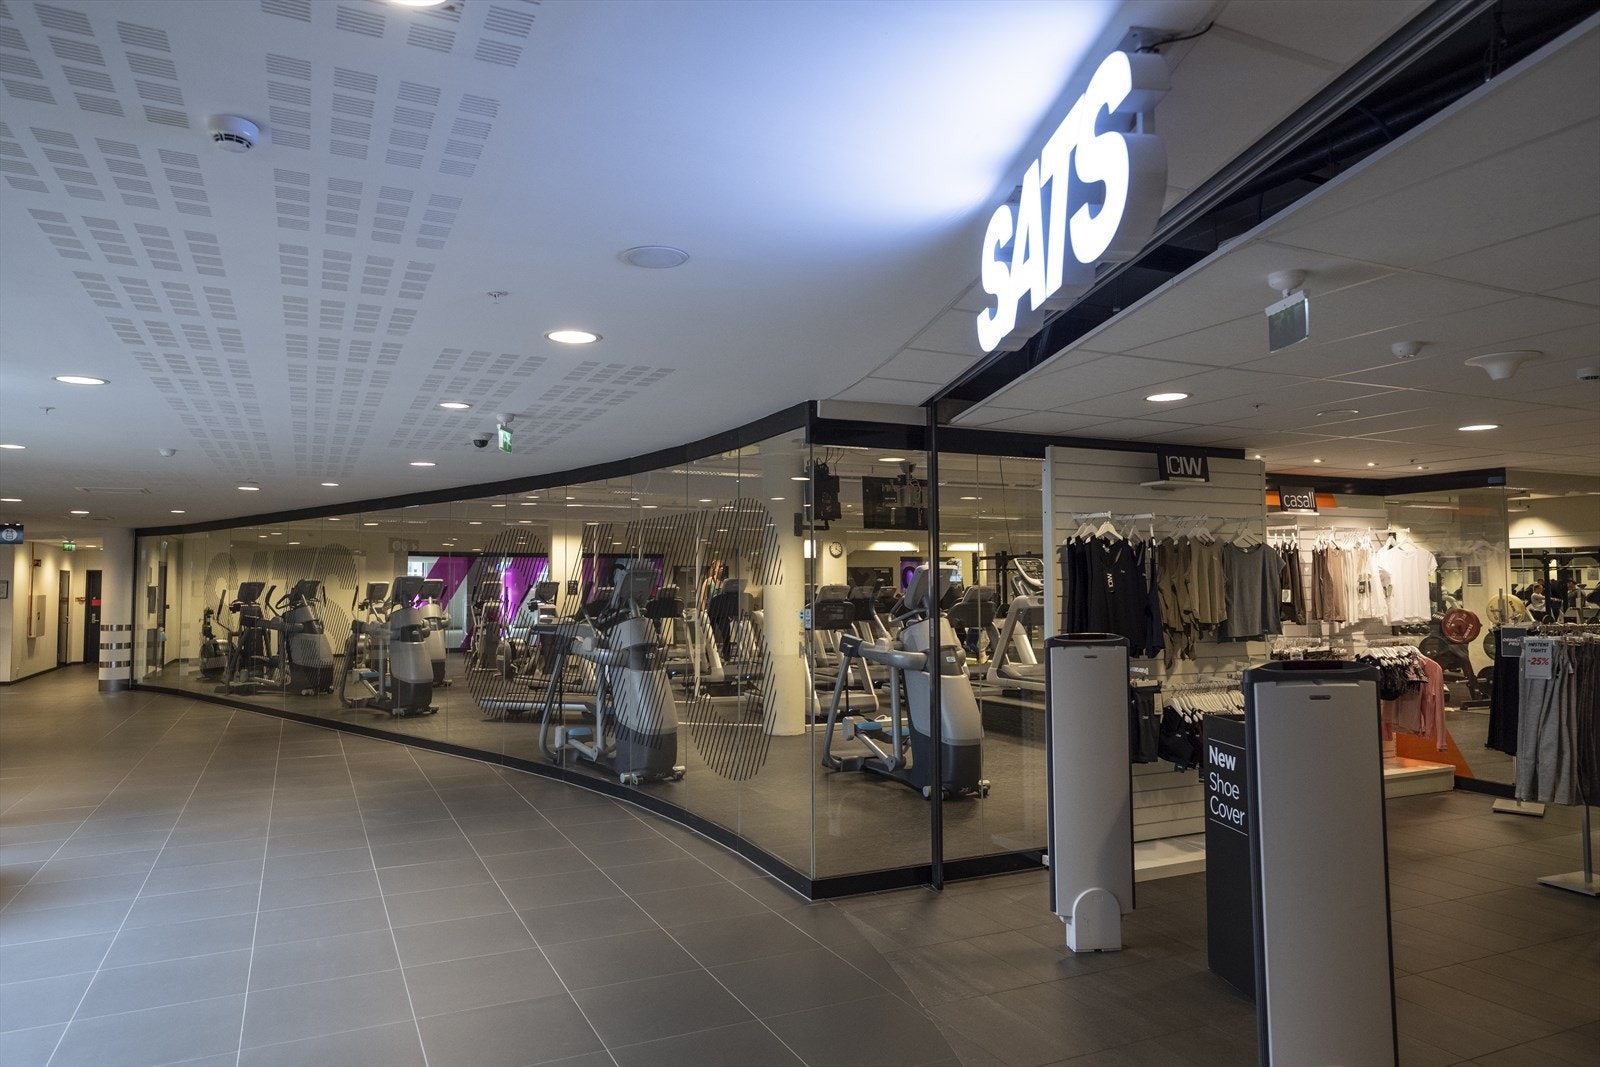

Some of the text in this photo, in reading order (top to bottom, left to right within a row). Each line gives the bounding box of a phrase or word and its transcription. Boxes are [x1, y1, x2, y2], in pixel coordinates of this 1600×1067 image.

[977, 50, 1132, 352] SATS
[1165, 455, 1202, 475] ICIW
[1283, 491, 1316, 508] casall
[1527, 657, 1550, 666] -25%
[1208, 744, 1237, 771] New
[1209, 771, 1240, 800] Shoe
[1210, 795, 1246, 826] Cover
